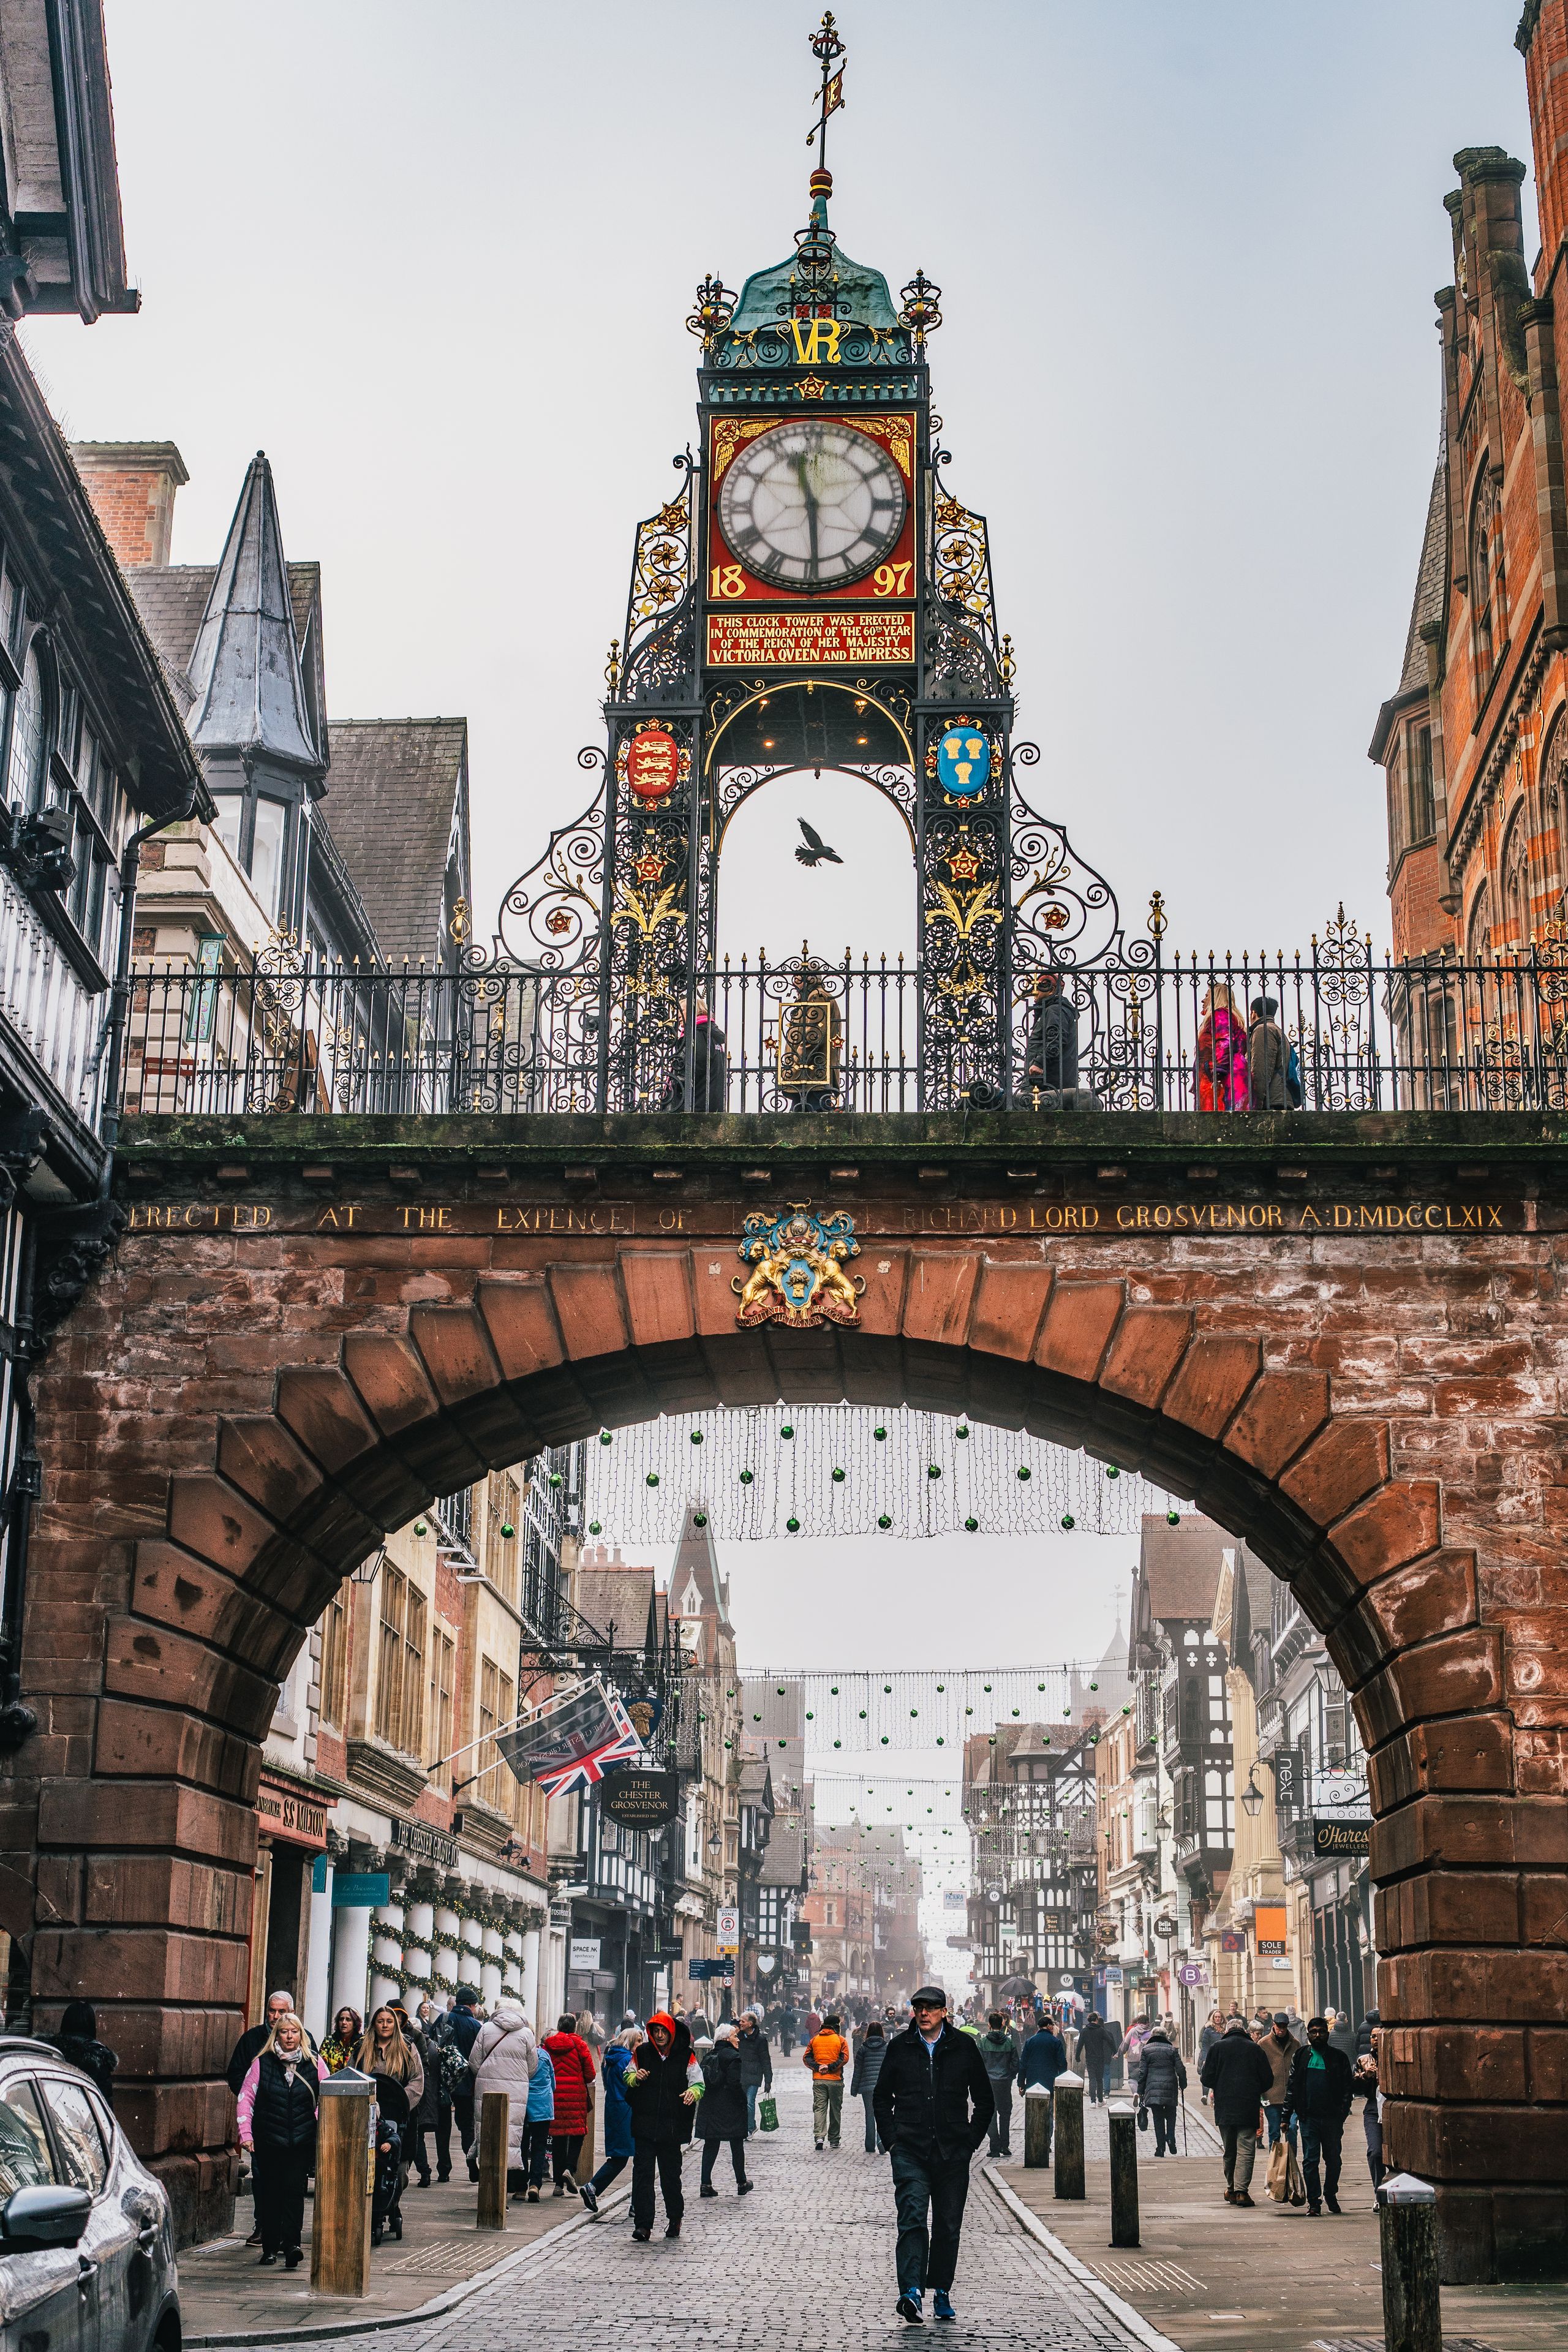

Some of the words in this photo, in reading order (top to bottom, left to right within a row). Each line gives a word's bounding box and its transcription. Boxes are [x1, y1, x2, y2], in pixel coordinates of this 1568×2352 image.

[710, 564, 747, 598] 18
[873, 560, 913, 597] 97
[717, 617, 743, 628] THIS
[747, 617, 780, 627] CLOCK
[786, 616, 824, 627] TOWER
[829, 616, 854, 626] WAS
[860, 615, 905, 625] ERECTED
[710, 628, 723, 639] IN
[726, 627, 822, 638] COMMEMORATION
[824, 627, 838, 637] OF
[842, 627, 861, 637] THE
[884, 626, 911, 636] YEAR
[720, 638, 734, 649] OF
[738, 638, 760, 649] THE
[764, 638, 796, 649] REIGN
[800, 638, 813, 648] OF
[818, 638, 840, 648] HER
[846, 636, 900, 647] MAJESTY
[823, 650, 847, 661] AND
[850, 647, 911, 661] EMPRESS.
[130, 1205, 271, 1228] ERECTED
[319, 1206, 363, 1227] AT
[397, 1207, 453, 1229] THE
[497, 1208, 625, 1230] EXPENCE
[659, 1209, 693, 1229] OF
[903, 1207, 1017, 1229] RICHARD
[1030, 1205, 1099, 1228] LORD
[1117, 1204, 1285, 1228] GROSVENOR
[772, 1316, 802, 1328] VIRTUS
[803, 1315, 821, 1327] NON
[1280, 1758, 1292, 1801] next
[611, 1801, 668, 1809] GROSVENOR
[296, 1804, 324, 1837] MILTON
[1328, 1810, 1368, 1819] LOOK
[398, 1820, 409, 1847] THE
[410, 1826, 432, 1856] CHESTER
